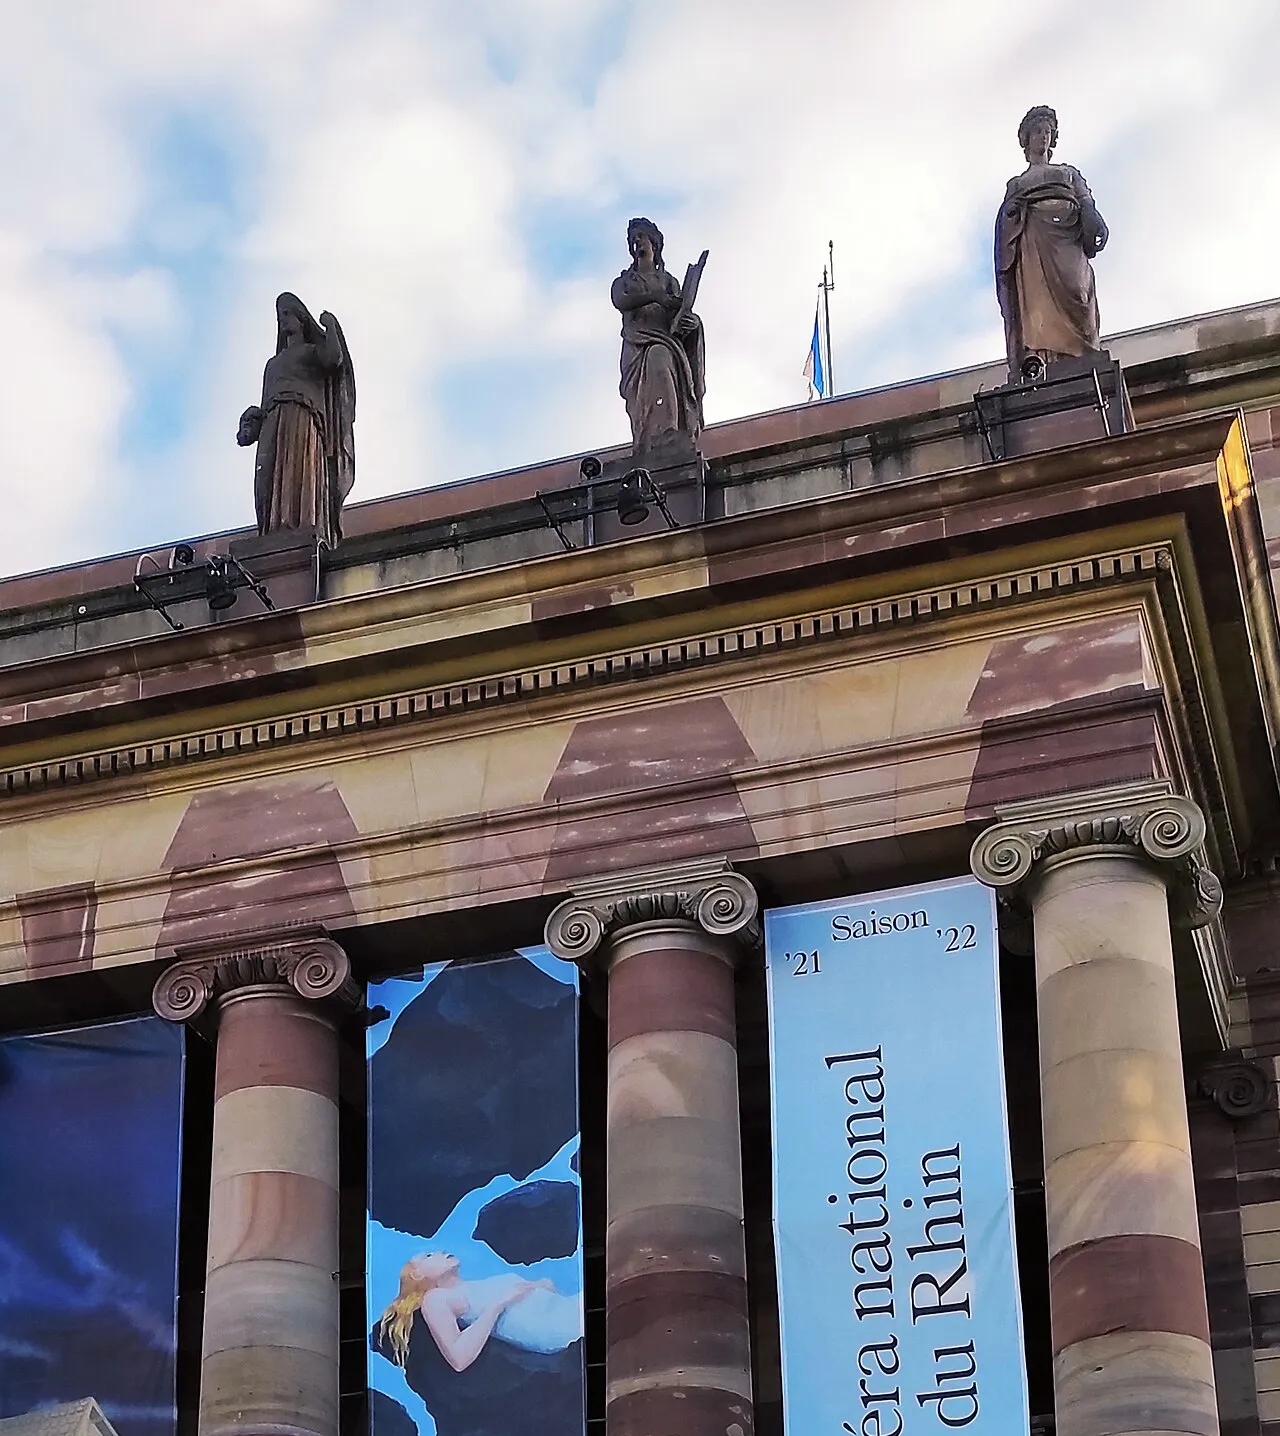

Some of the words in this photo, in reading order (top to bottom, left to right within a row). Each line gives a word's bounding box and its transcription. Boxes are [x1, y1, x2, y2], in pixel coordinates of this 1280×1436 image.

[831, 909, 929, 942] Saison
[936, 924, 978, 953] '22
[784, 949, 822, 977] '21
[824, 1044, 896, 1322] national
[902, 1142, 973, 1326] Rhin
[915, 1338, 979, 1428] du
